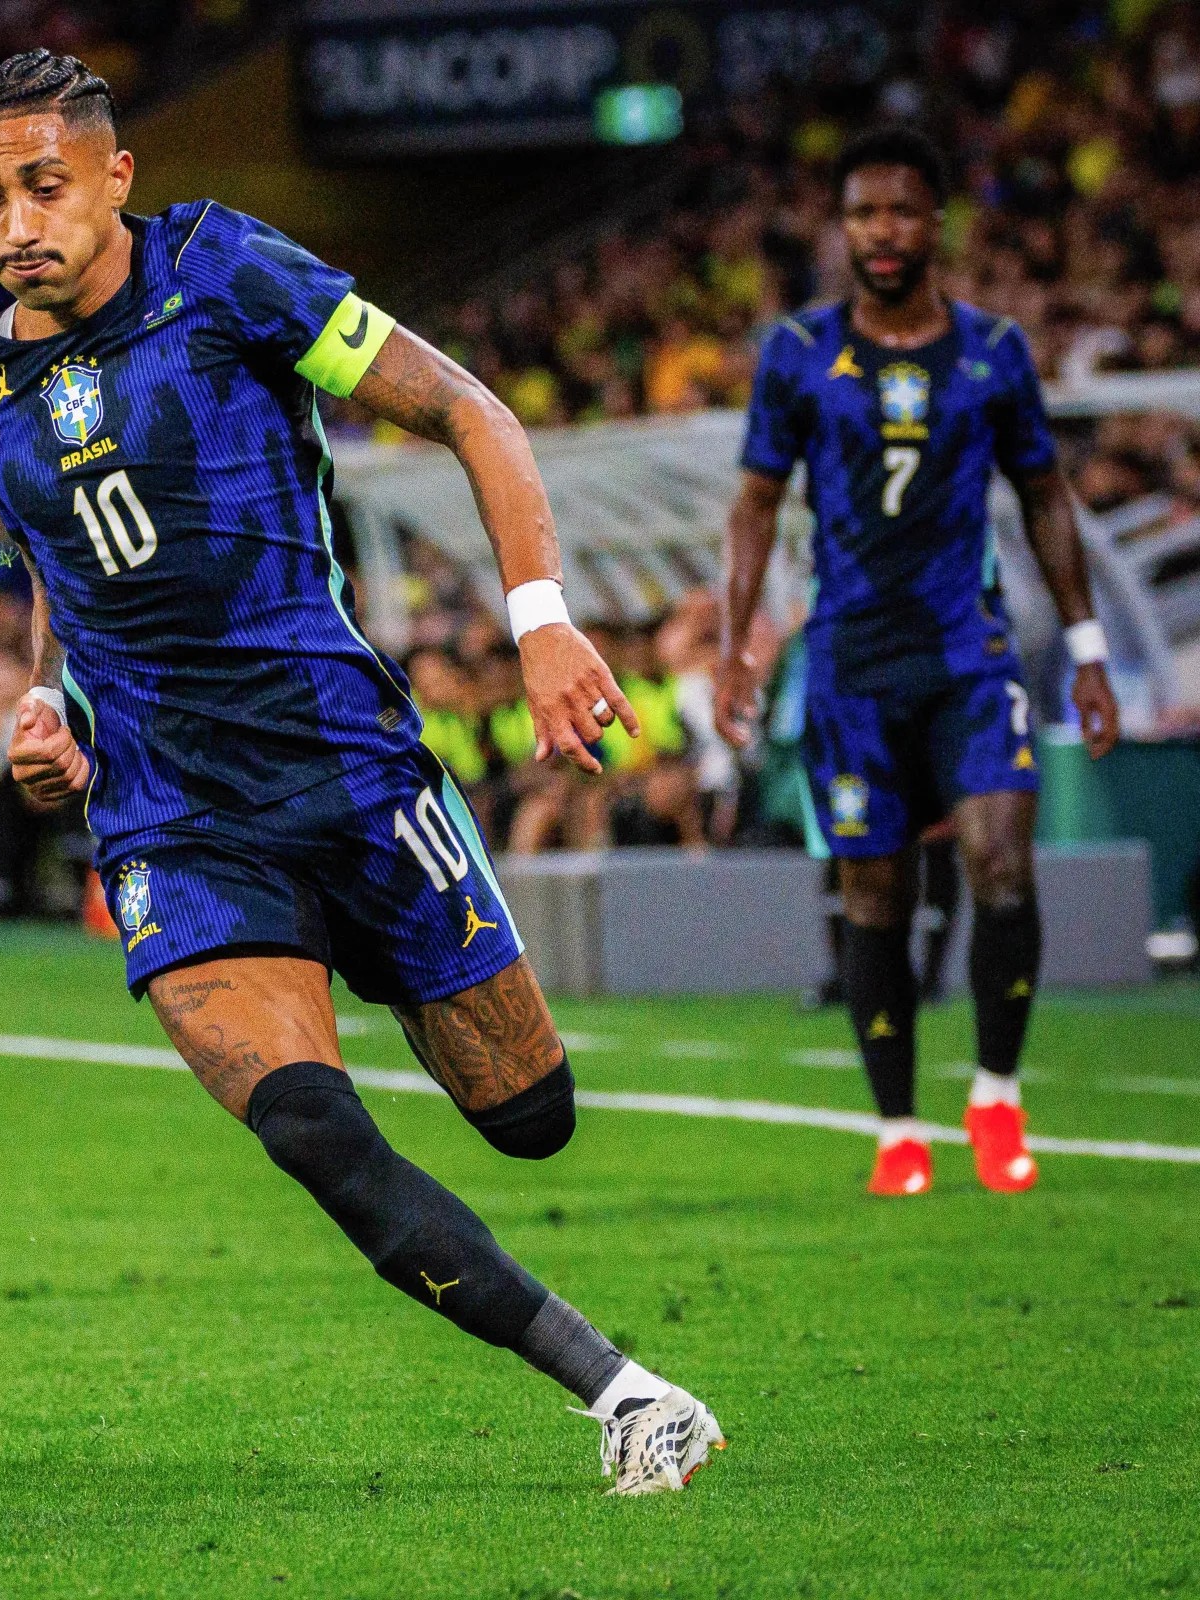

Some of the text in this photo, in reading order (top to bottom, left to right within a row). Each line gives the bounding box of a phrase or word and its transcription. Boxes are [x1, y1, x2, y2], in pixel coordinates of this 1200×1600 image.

[65, 396, 85, 412] CBF
[60, 437, 118, 472] BRASIL
[881, 446, 921, 518] 7
[73, 469, 158, 577] 10
[394, 785, 469, 893] 10
[127, 921, 162, 953] BRASIL
